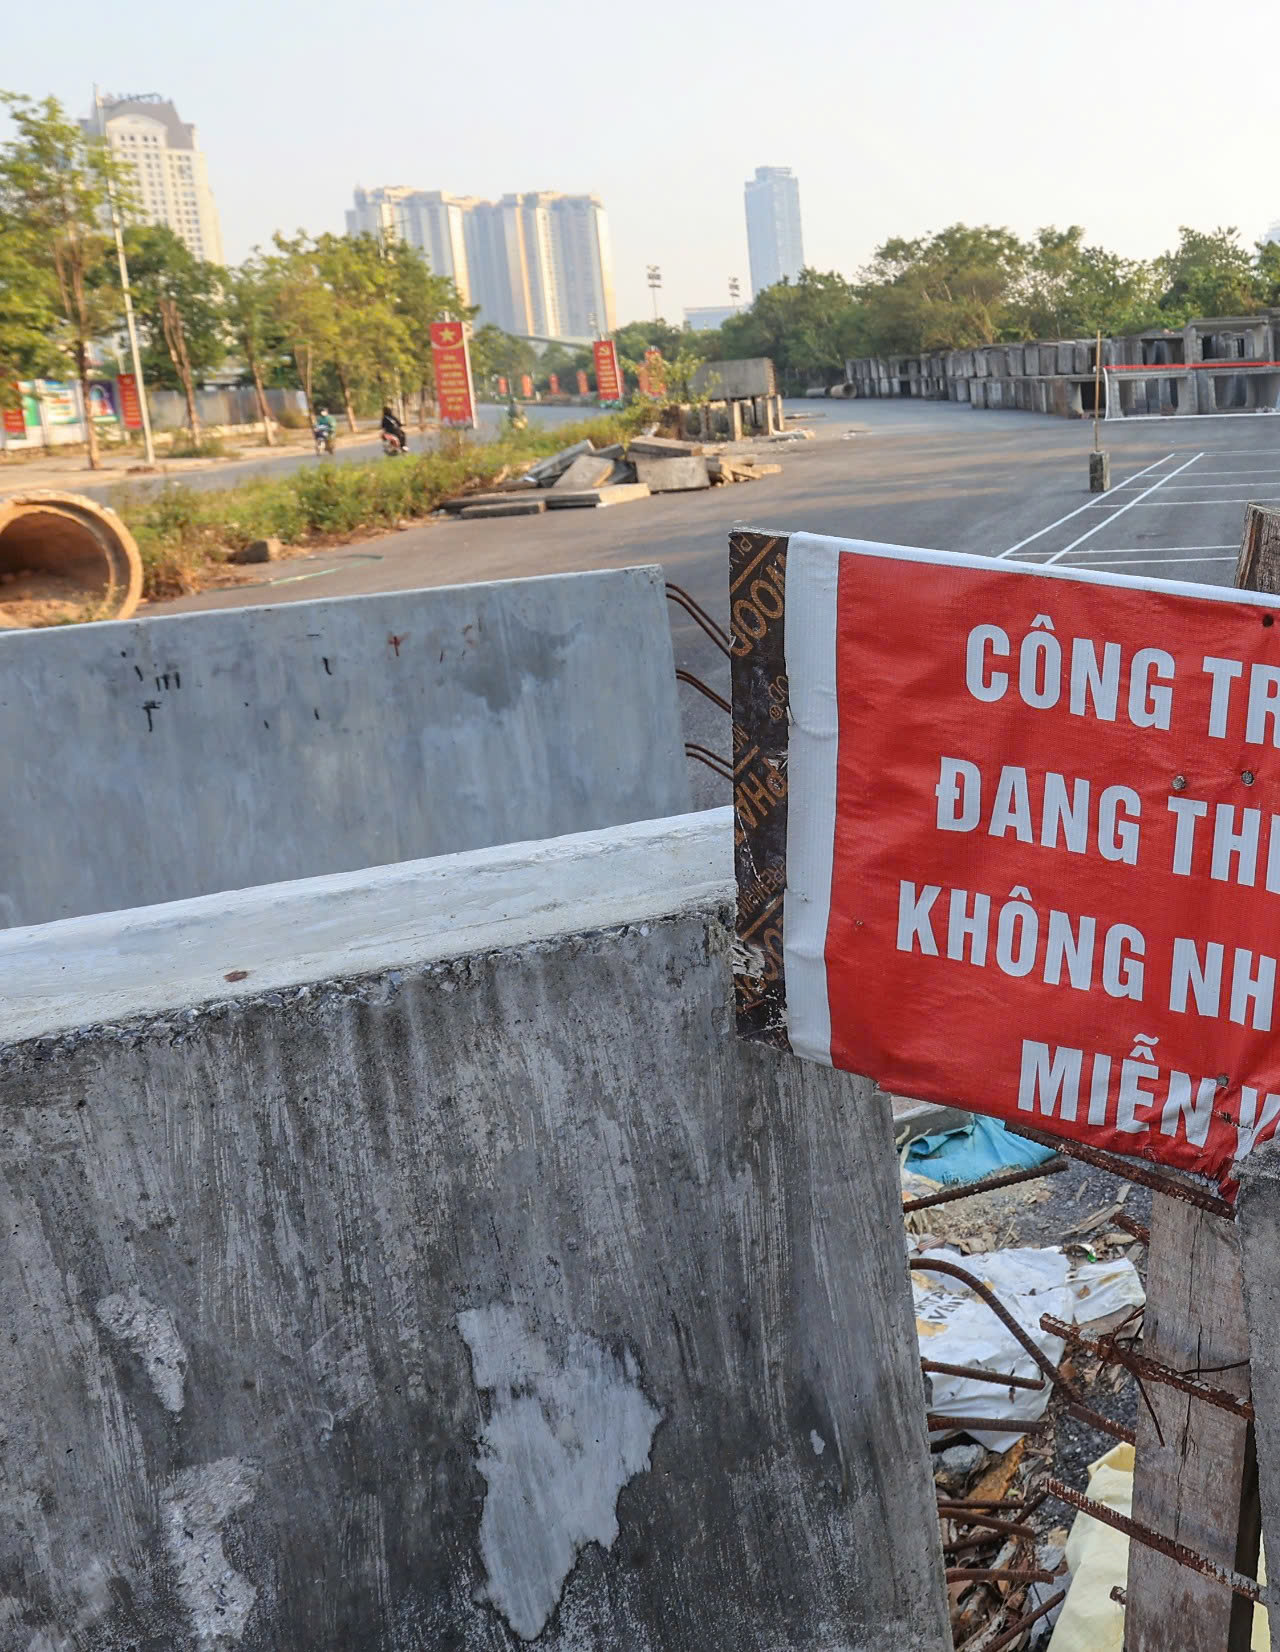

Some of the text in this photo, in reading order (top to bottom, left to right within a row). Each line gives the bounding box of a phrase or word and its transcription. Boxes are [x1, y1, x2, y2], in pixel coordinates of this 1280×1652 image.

[966, 614, 1176, 731] CÔNG
[935, 757, 1141, 865] ĐANG
[897, 880, 1145, 1001] KHÔNG
[1018, 1033, 1219, 1146] MIỄN
